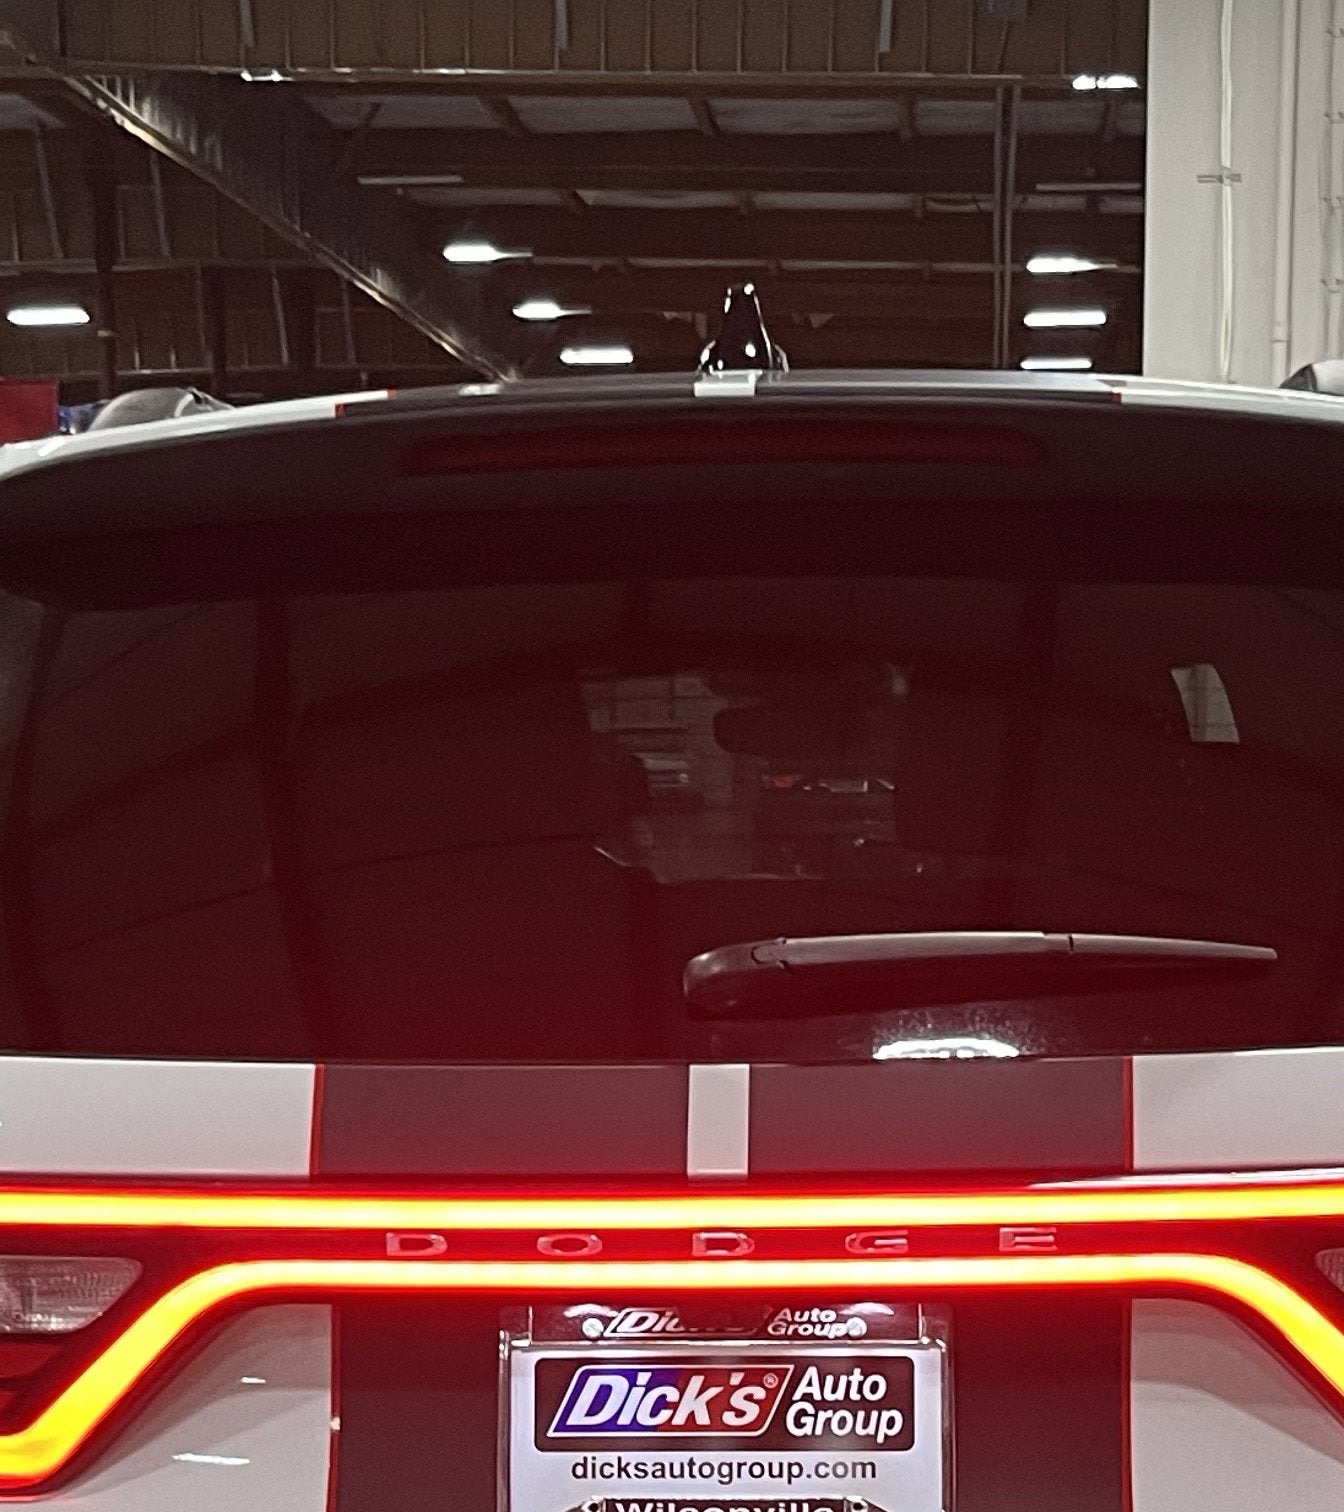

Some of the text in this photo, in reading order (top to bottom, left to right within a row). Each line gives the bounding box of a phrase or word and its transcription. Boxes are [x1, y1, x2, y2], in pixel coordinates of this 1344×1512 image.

[386, 1227, 1057, 1258] DODGE
[767, 1322, 848, 1338] Group
[773, 1308, 837, 1323] Auto
[792, 1366, 887, 1402] Auto
[785, 1402, 903, 1444] Group
[571, 1456, 878, 1485] dicksautogroup.com
